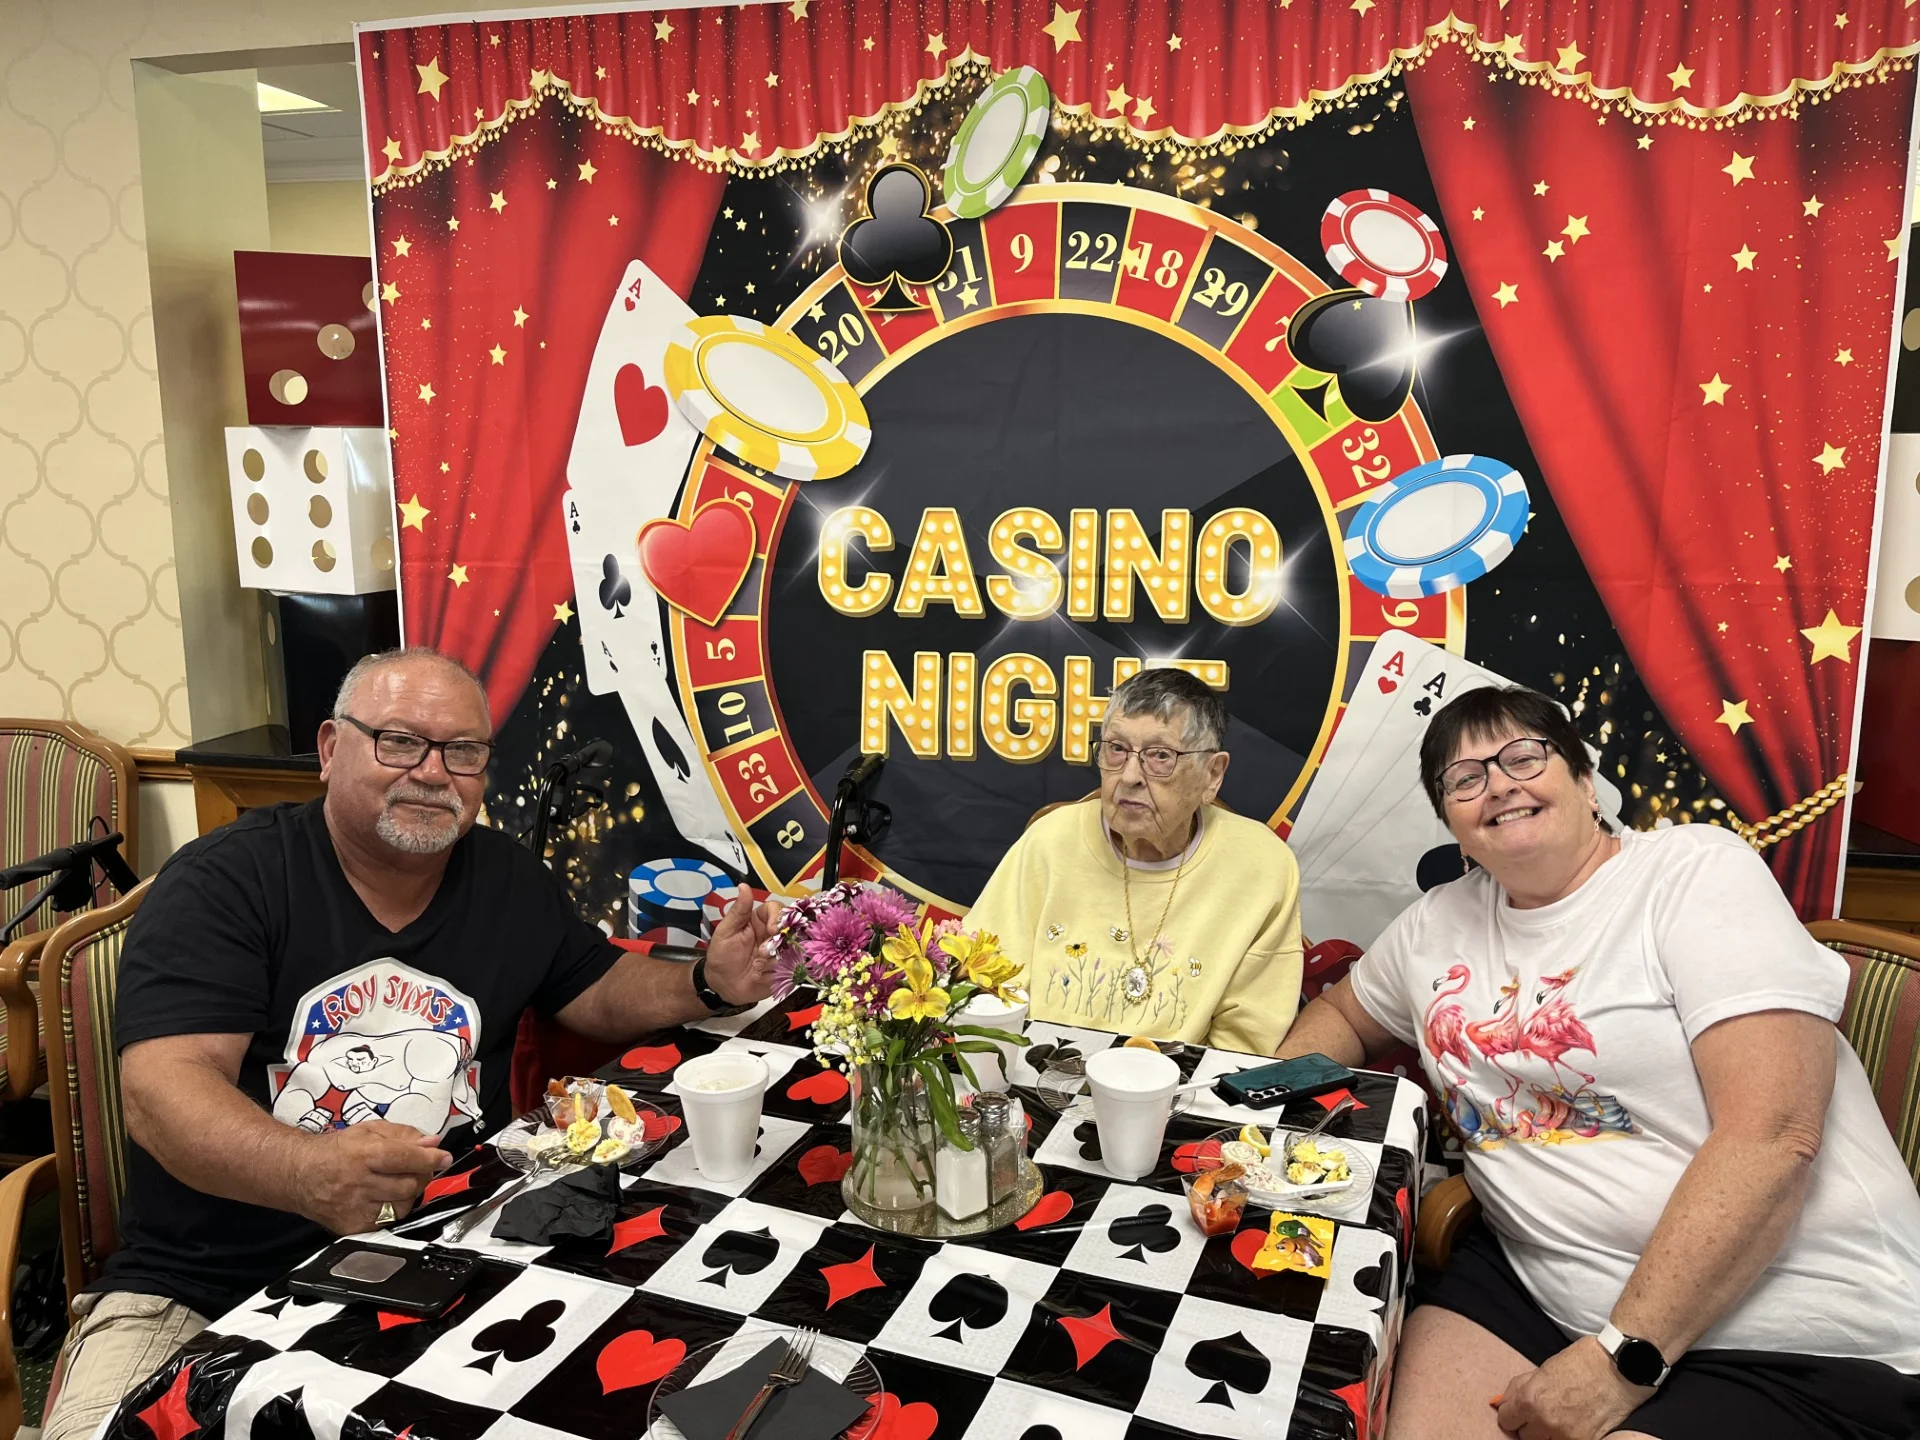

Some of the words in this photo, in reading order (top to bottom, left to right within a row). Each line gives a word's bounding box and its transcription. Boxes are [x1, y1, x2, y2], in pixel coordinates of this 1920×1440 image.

[1009, 233, 1034, 274] 9
[1065, 230, 1119, 273] 22
[1127, 239, 1185, 289] 18
[628, 277, 644, 300] A
[1192, 267, 1250, 317] 29
[818, 312, 865, 367] 20
[1341, 427, 1392, 489] 32
[569, 501, 580, 519] A
[817, 505, 1284, 627] CASINO
[705, 637, 736, 661] 5
[1382, 650, 1405, 677] A
[1423, 671, 1447, 699] A
[717, 691, 755, 744] 10
[738, 752, 779, 804] 23
[776, 819, 805, 850] 8
[321, 974, 377, 1030] ROY
[383, 974, 455, 1026] SIMS
